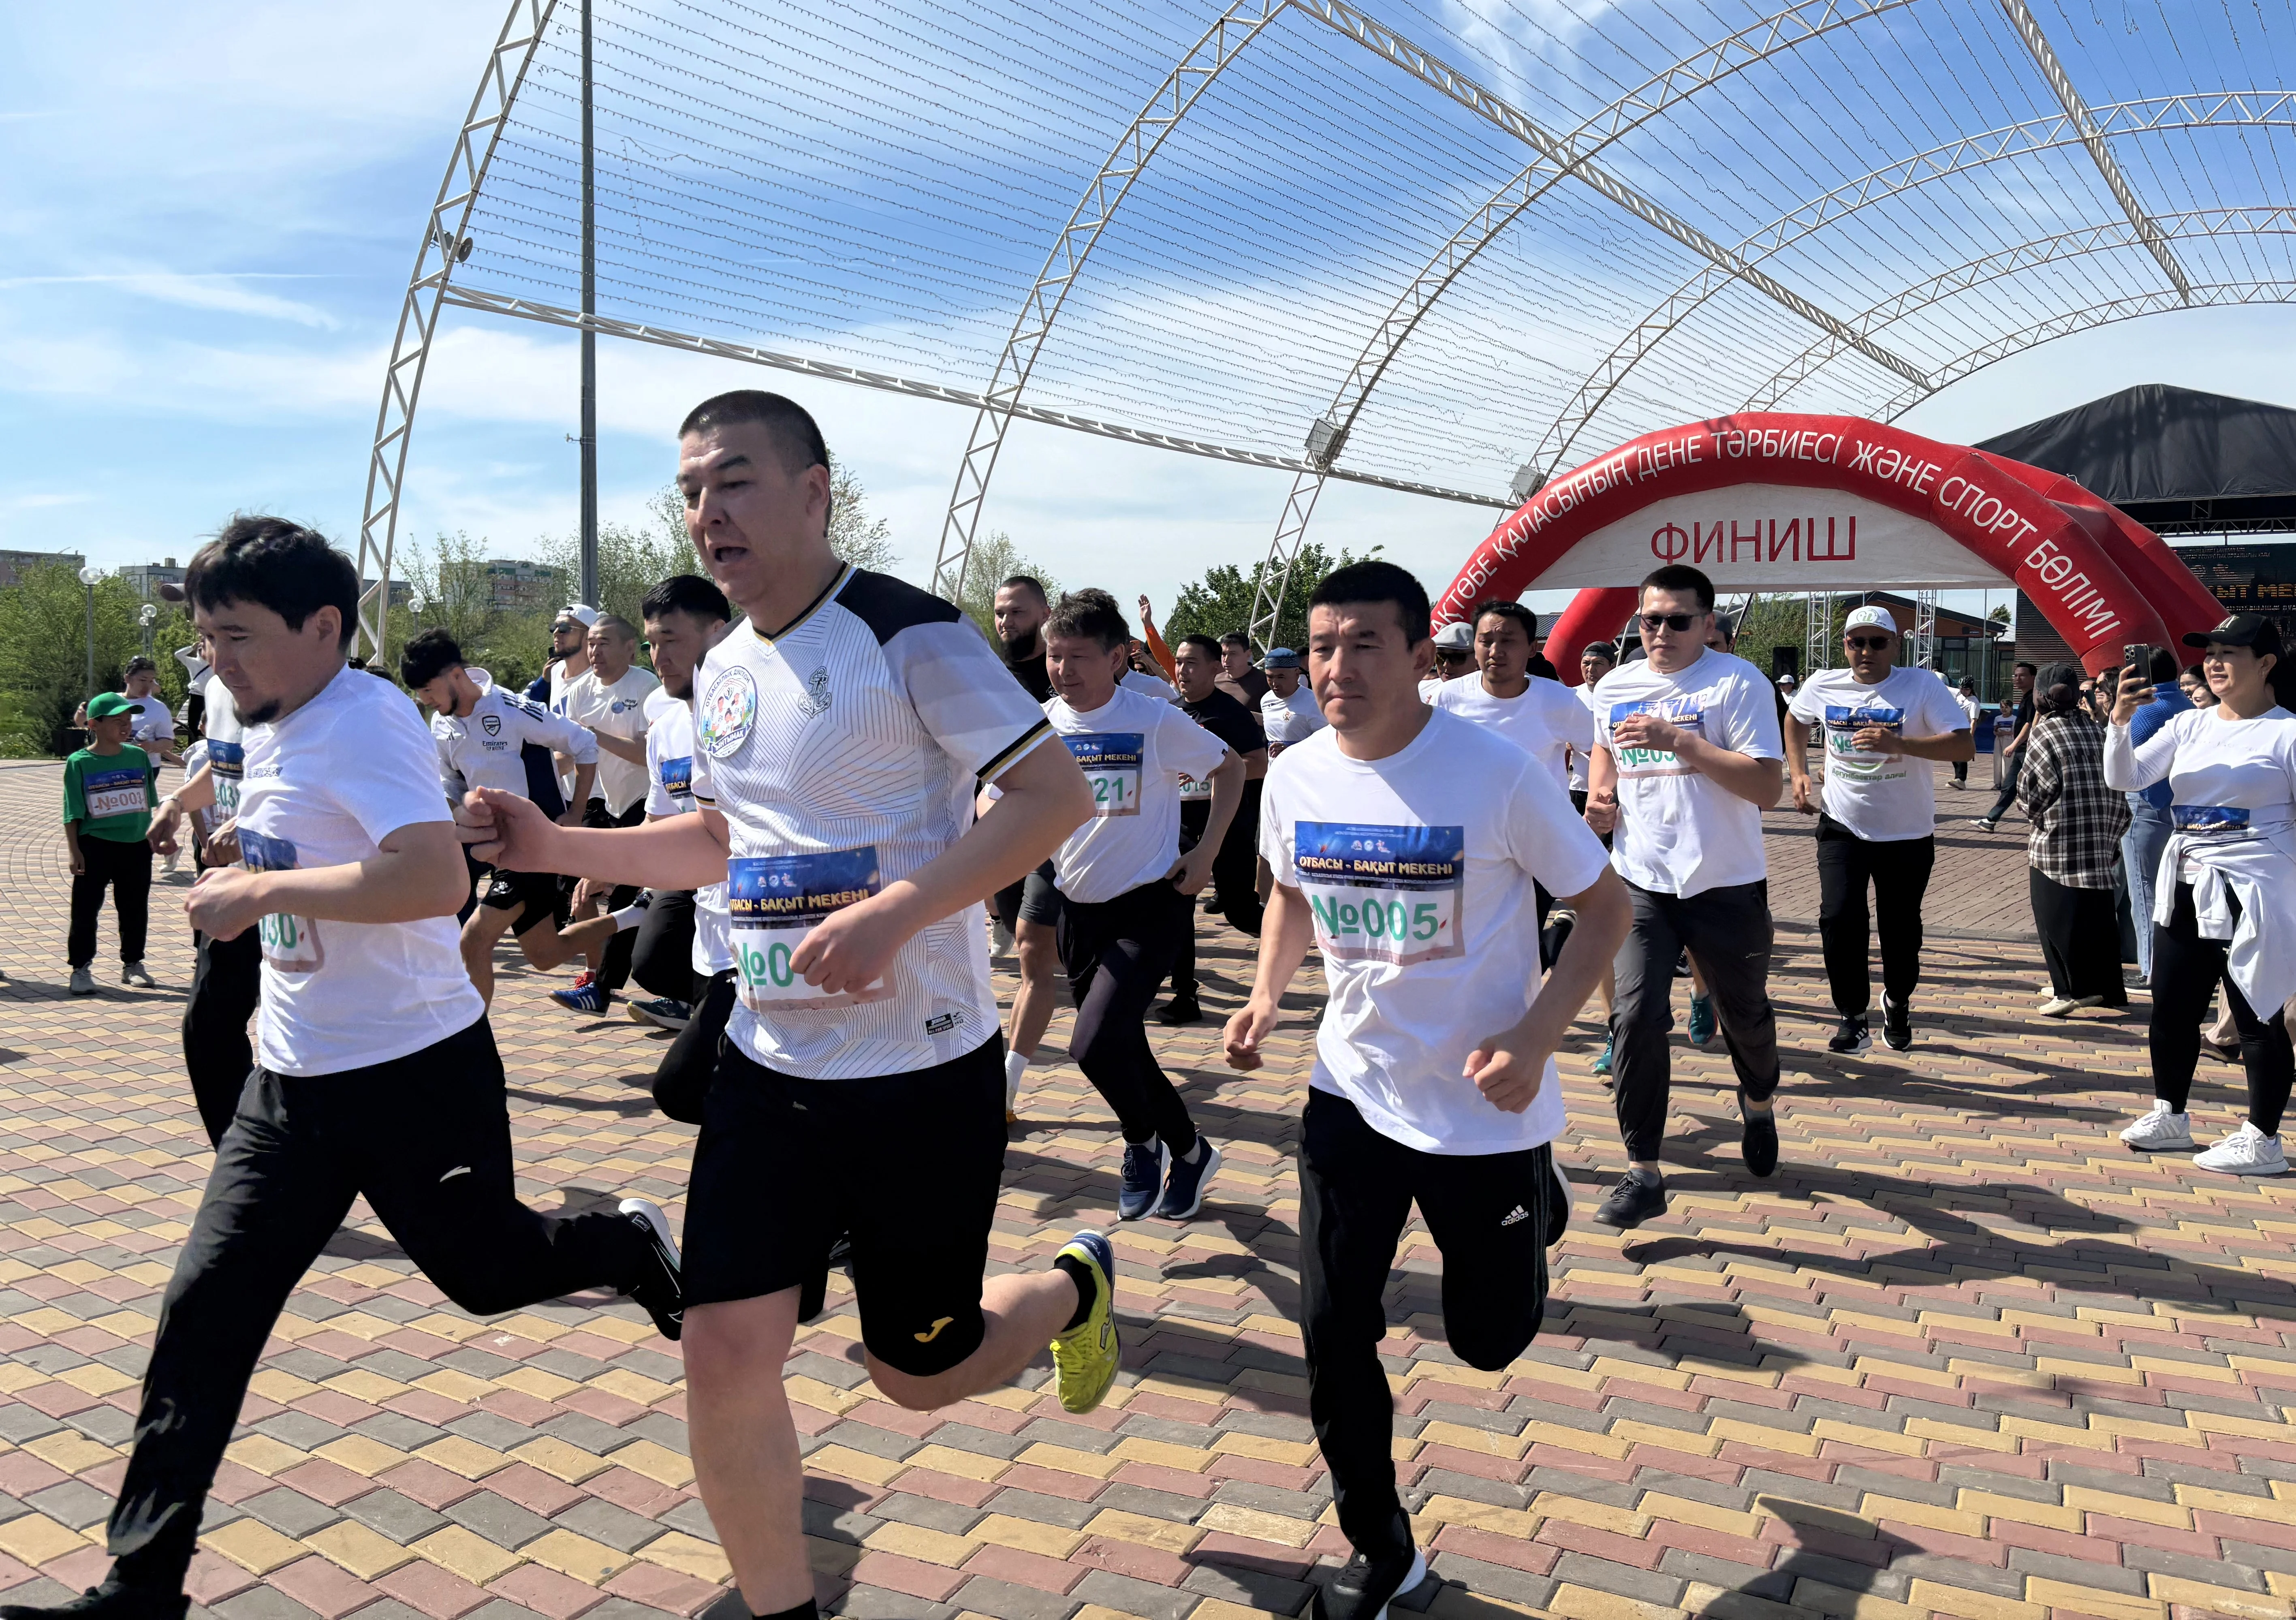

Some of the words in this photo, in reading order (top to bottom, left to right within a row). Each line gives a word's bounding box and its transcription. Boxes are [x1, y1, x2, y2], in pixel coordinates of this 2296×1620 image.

[1431, 553, 1497, 633] АҚТӨБЕ
[1493, 455, 1633, 561] ҚАЛАСЫНЫҢ
[1638, 435, 1702, 482] ДЕНЕ
[1711, 429, 1843, 464] ТӘРБИЕСІ
[1847, 440, 1942, 495] ЖӘНЕ
[1939, 477, 2038, 547] СПОРТ
[2025, 539, 2121, 639] БӨЛІМІ
[1651, 516, 1857, 564] ФИНИШ
[1088, 777, 1123, 802] 21
[1299, 856, 1343, 871] ОТБАСЫ
[1354, 859, 1397, 875] БАҚЫТ
[1399, 862, 1453, 875] МЕКЕНІ
[760, 896, 805, 913] БАҚЫТ
[808, 888, 869, 909] МЕКЕНІ
[1501, 1211, 1529, 1226] adidas
